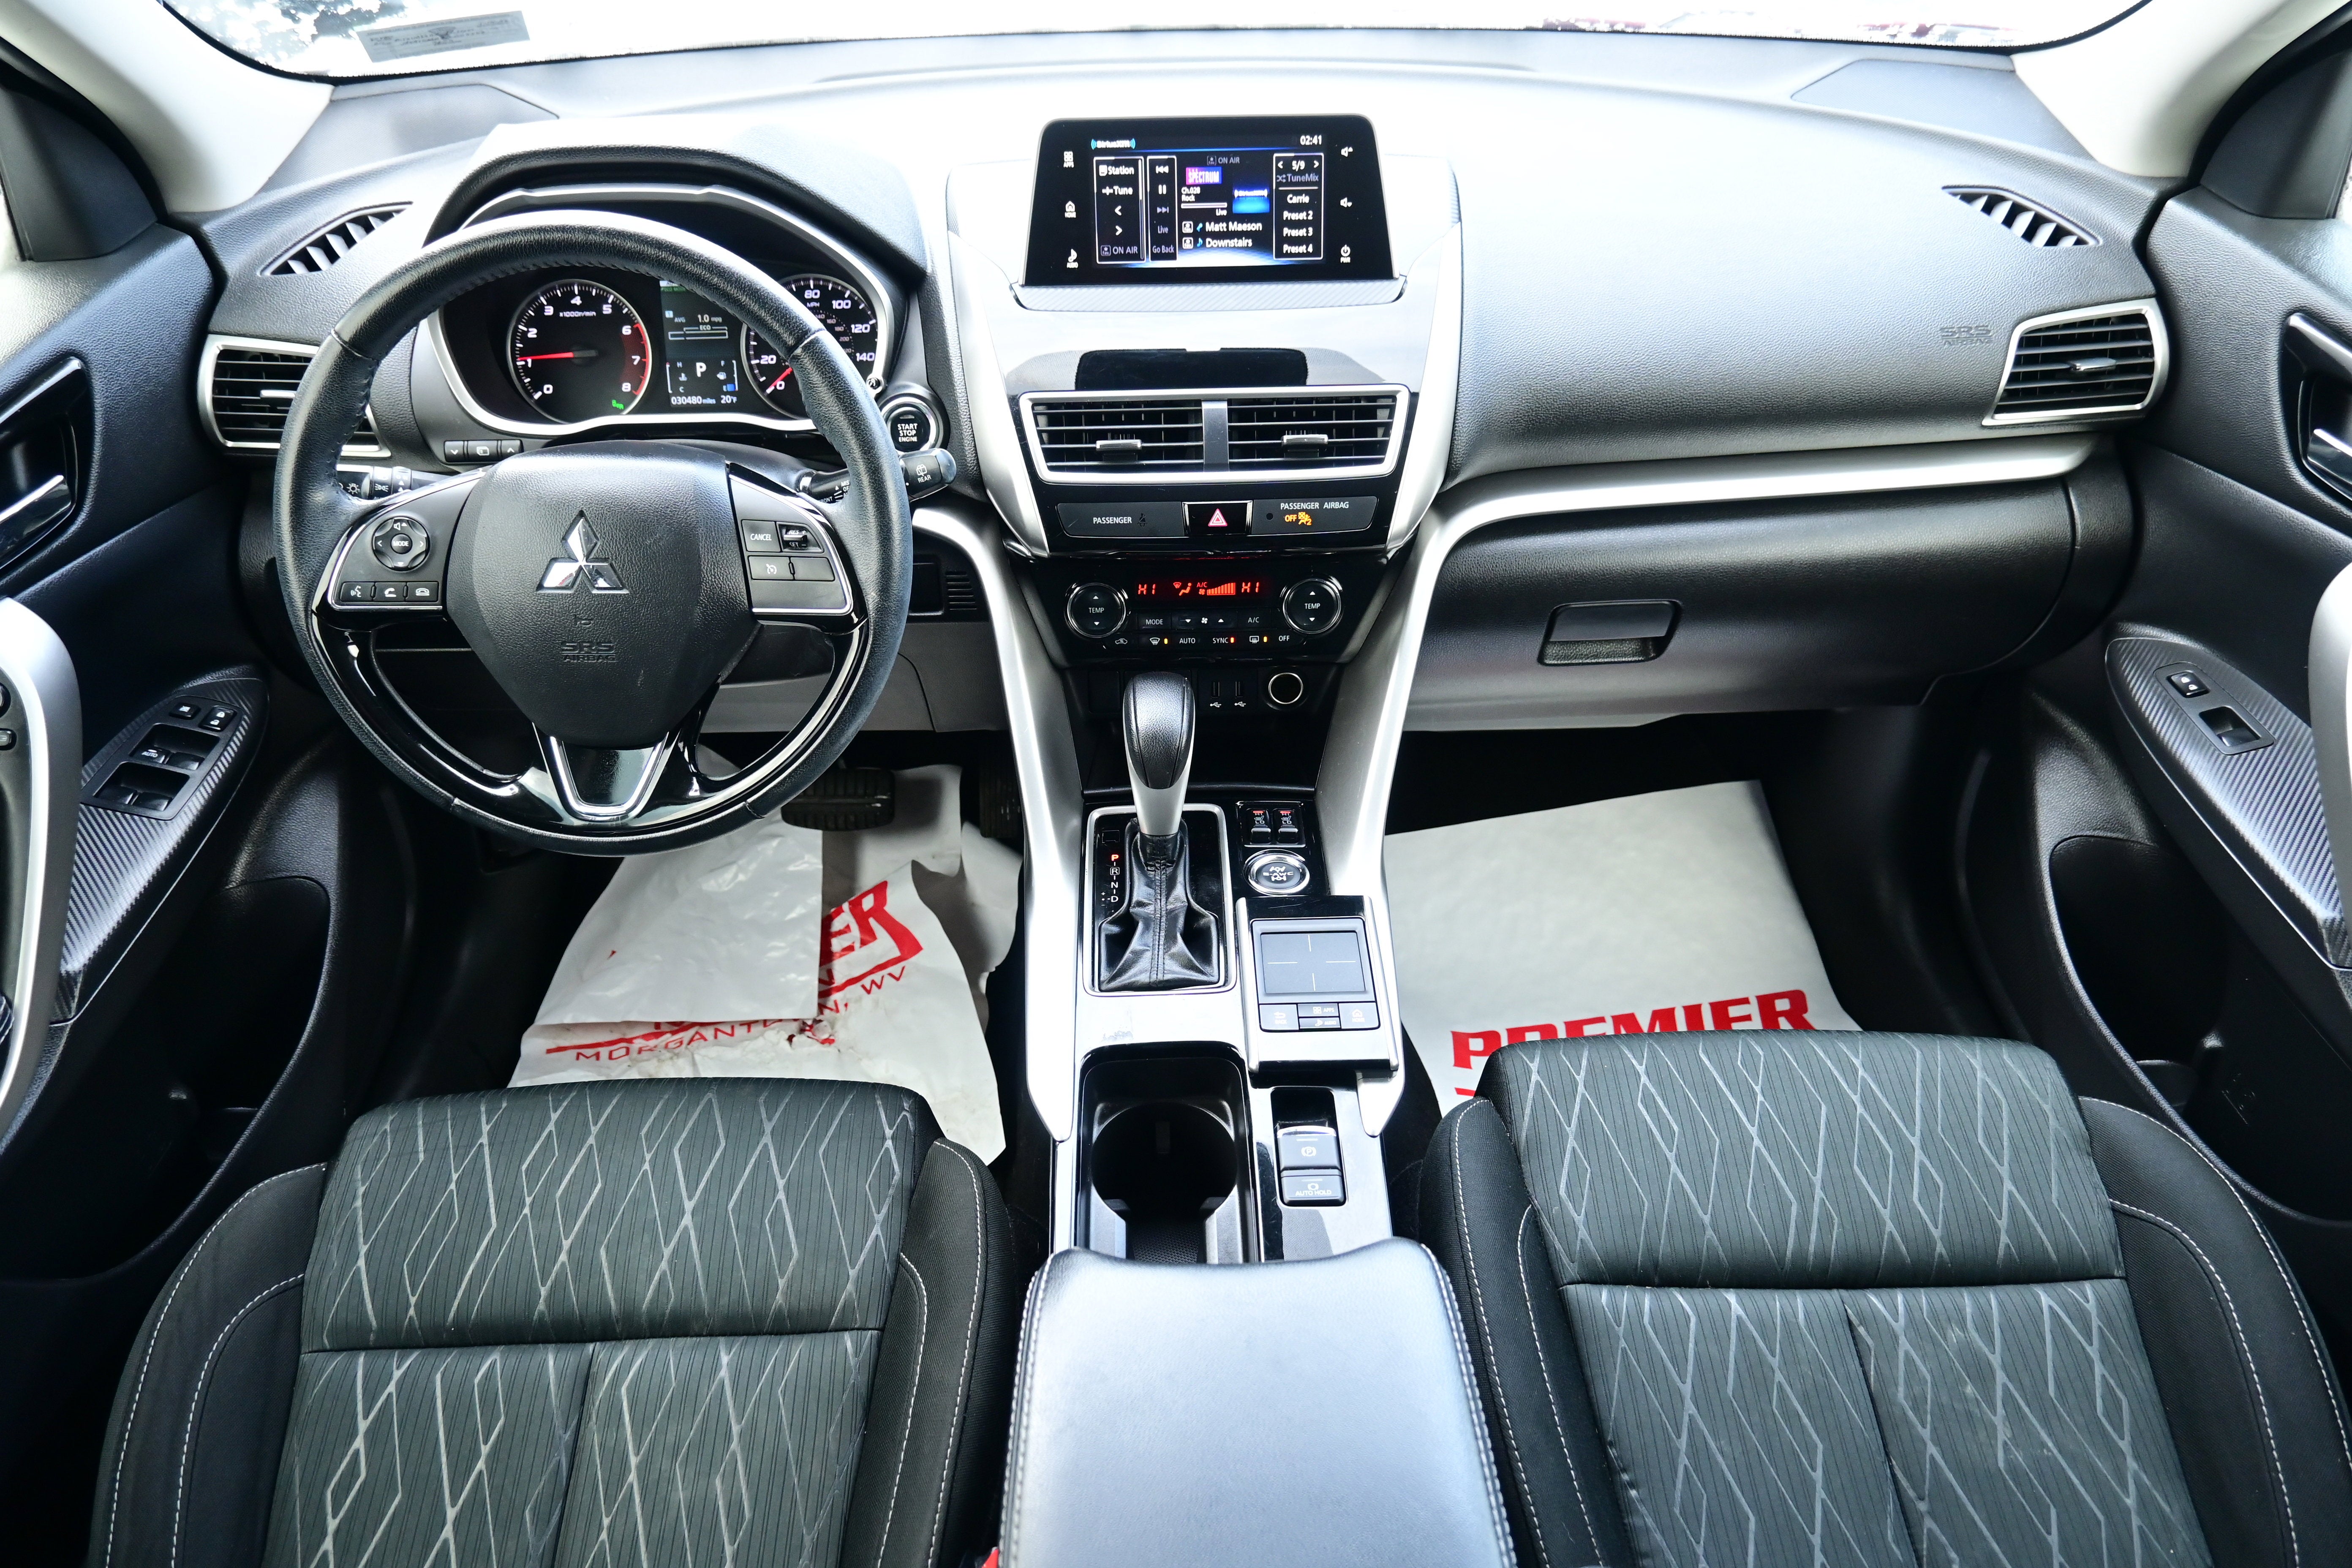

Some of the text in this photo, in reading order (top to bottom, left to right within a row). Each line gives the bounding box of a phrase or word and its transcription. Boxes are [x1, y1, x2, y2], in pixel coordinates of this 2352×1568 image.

[1300, 135, 1322, 145] 02:41
[1108, 166, 1135, 175] Station
[1292, 160, 1305, 172] 5/9
[1188, 170, 1220, 183] SPECTRUM
[1287, 172, 1319, 182] TuneMix
[1113, 186, 1133, 195] Tune
[1283, 210, 1313, 220] Preset 2
[1157, 225, 1169, 234] Live
[1206, 221, 1262, 232] Matt Maeson
[1283, 227, 1313, 237] Preset 3
[1206, 237, 1252, 248] Downstairs
[1113, 246, 1138, 254] ON AIR
[1152, 245, 1174, 253] Go Back
[1283, 243, 1313, 254] Preset 4
[804, 289, 820, 299] 80
[571, 296, 582, 305] 4
[832, 300, 852, 309] 100
[544, 305, 554, 316] 3
[602, 304, 612, 314] 5
[697, 314, 710, 323] 1.0
[527, 328, 537, 338] 2
[622, 326, 632, 335] 6
[851, 324, 870, 333] 120
[1940, 325, 1992, 338] SRS
[632, 355, 640, 365] 7
[760, 355, 776, 365] 20
[856, 352, 875, 362] 140
[526, 359, 532, 368] 1
[696, 362, 707, 377] P
[543, 384, 553, 394] 0
[622, 383, 631, 392] 8
[776, 381, 785, 390] 0
[917, 474, 932, 483] REAR
[561, 641, 616, 653] SRS
[861, 965, 905, 995] WV
